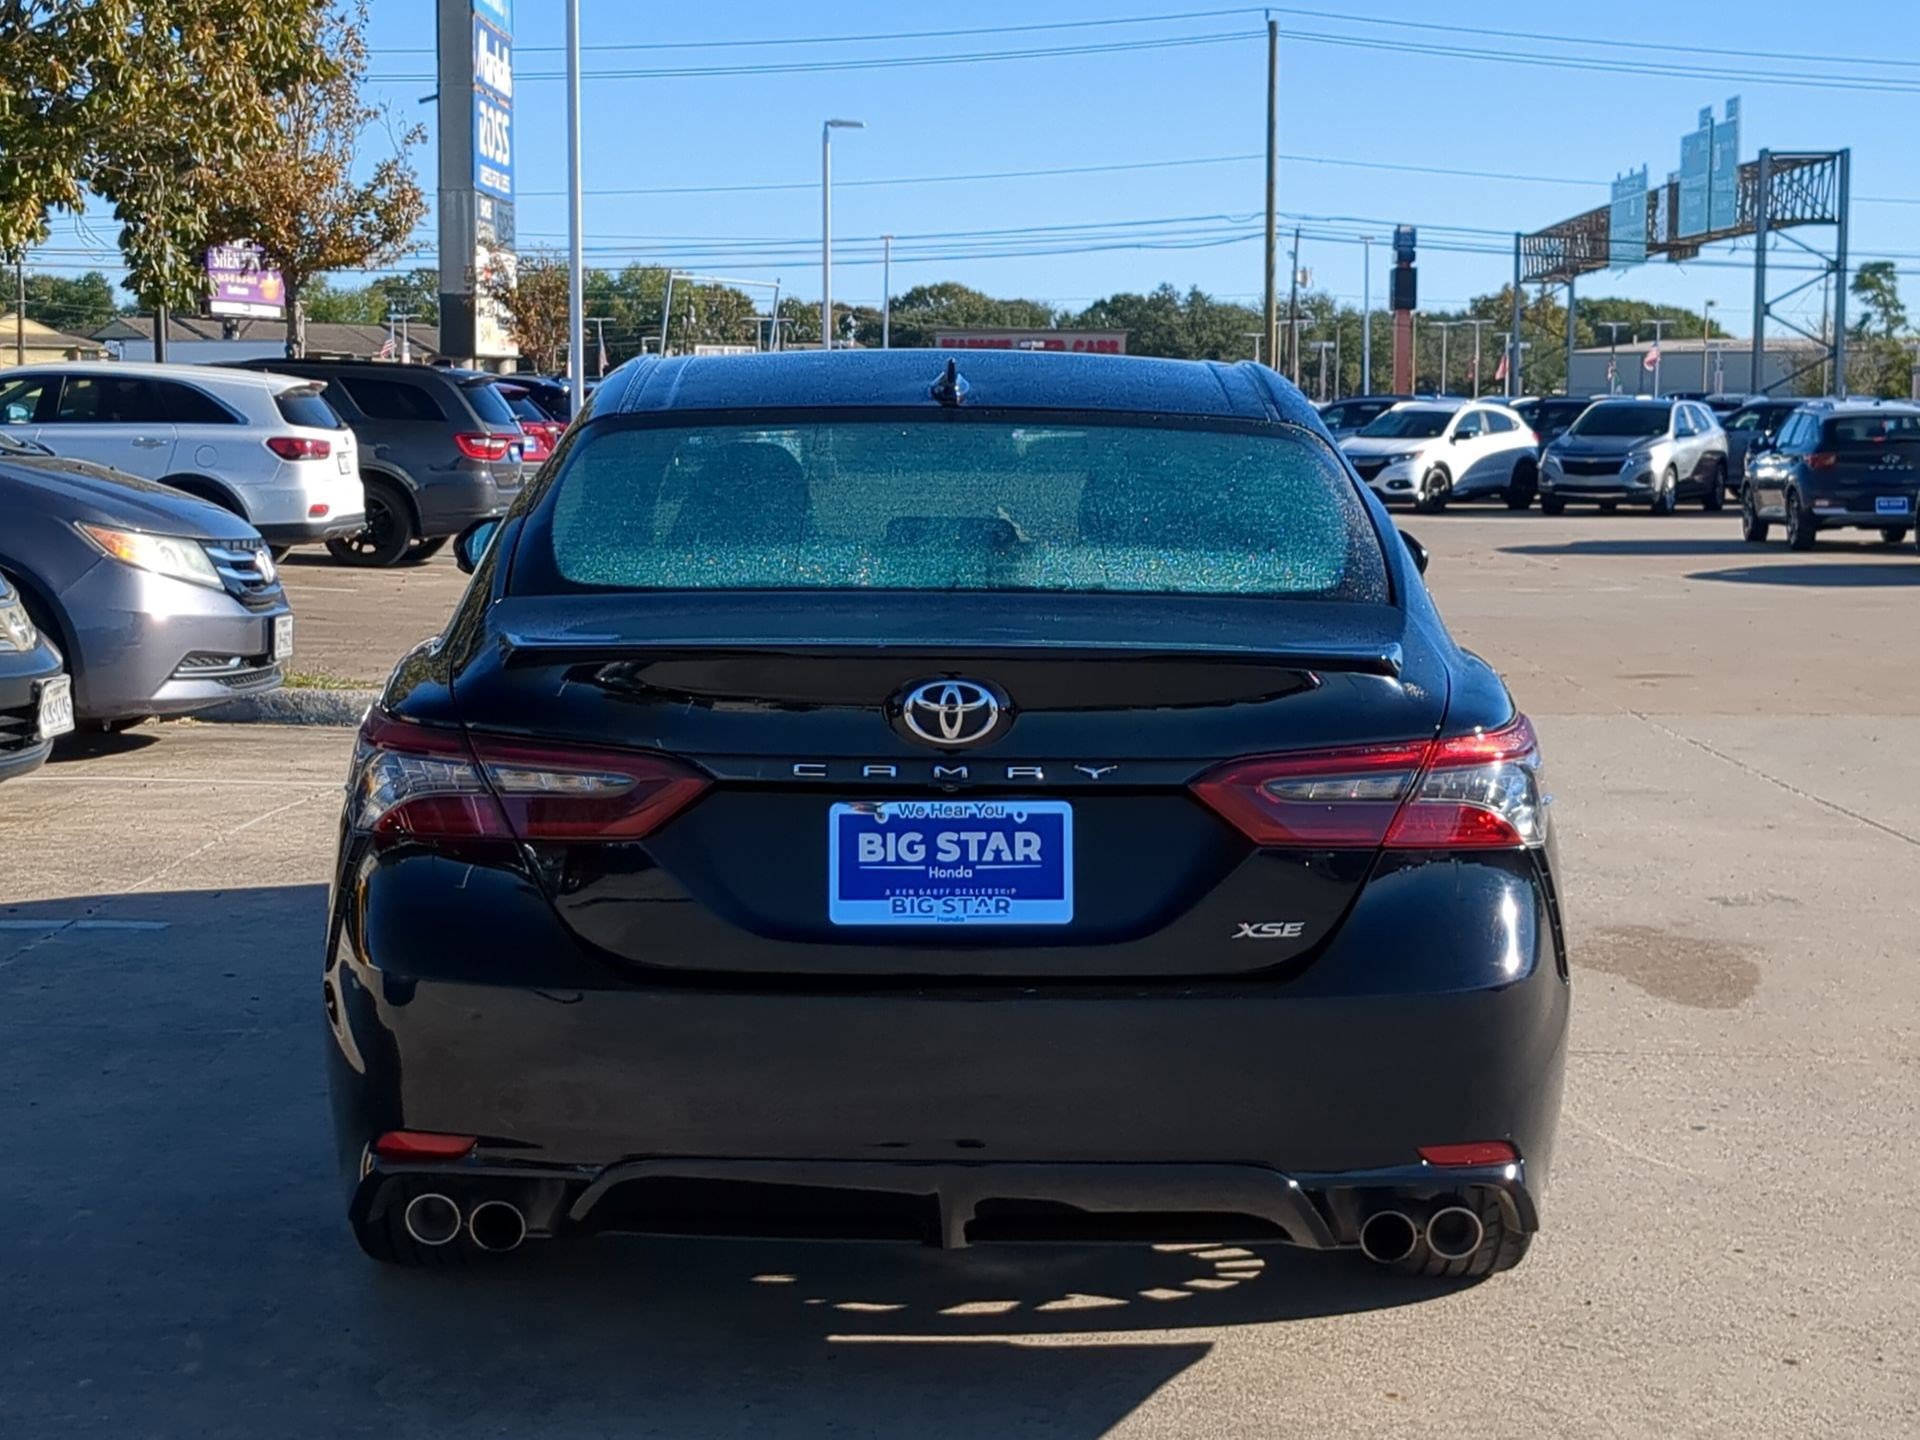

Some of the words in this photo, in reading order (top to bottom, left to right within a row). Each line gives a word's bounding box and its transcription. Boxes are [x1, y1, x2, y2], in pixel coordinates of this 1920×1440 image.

[479, 100, 510, 166] ROSS
[793, 763, 1118, 779] CAMRY
[898, 803, 925, 817] We
[930, 803, 972, 818] Hear
[975, 803, 1006, 818] You
[858, 832, 926, 862] BIG
[936, 831, 1042, 862] STAR
[928, 866, 973, 879] Honda
[891, 897, 934, 914] BIG
[942, 897, 1011, 914] STAR
[1231, 922, 1305, 938] XSE
